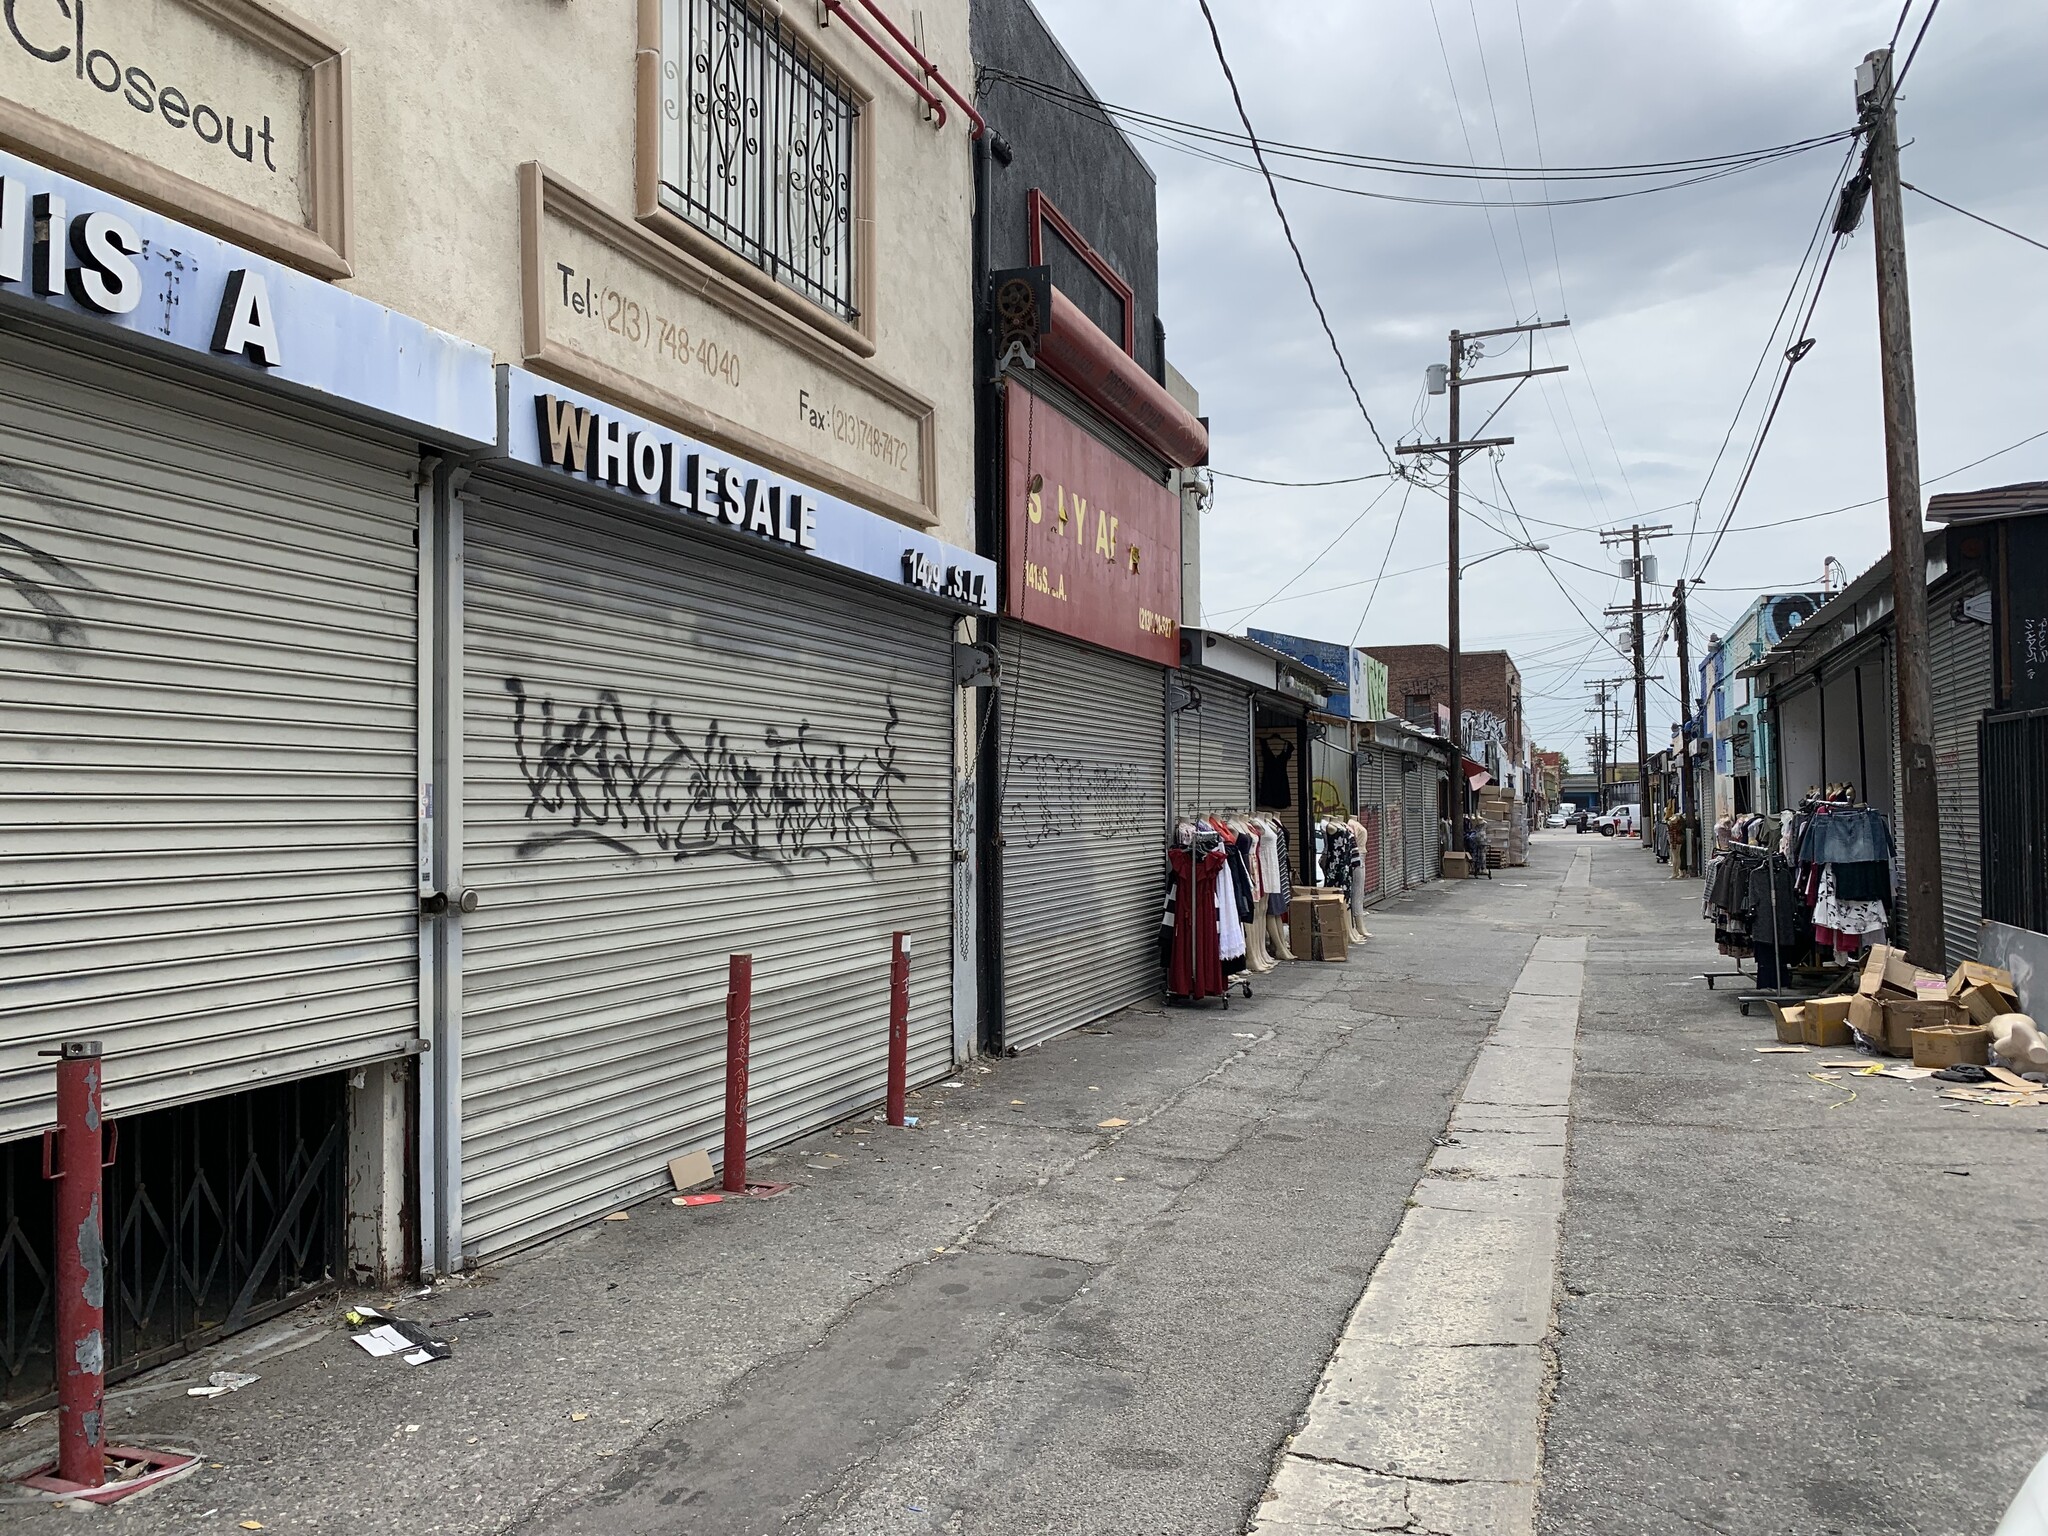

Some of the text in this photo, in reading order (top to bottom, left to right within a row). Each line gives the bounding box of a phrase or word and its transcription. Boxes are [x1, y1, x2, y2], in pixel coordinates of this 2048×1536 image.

[4, 0, 276, 172] Closeout
[600, 285, 650, 348] (213)
[656, 315, 740, 388] 748-4040
[534, 394, 817, 550] WHOLESALE
